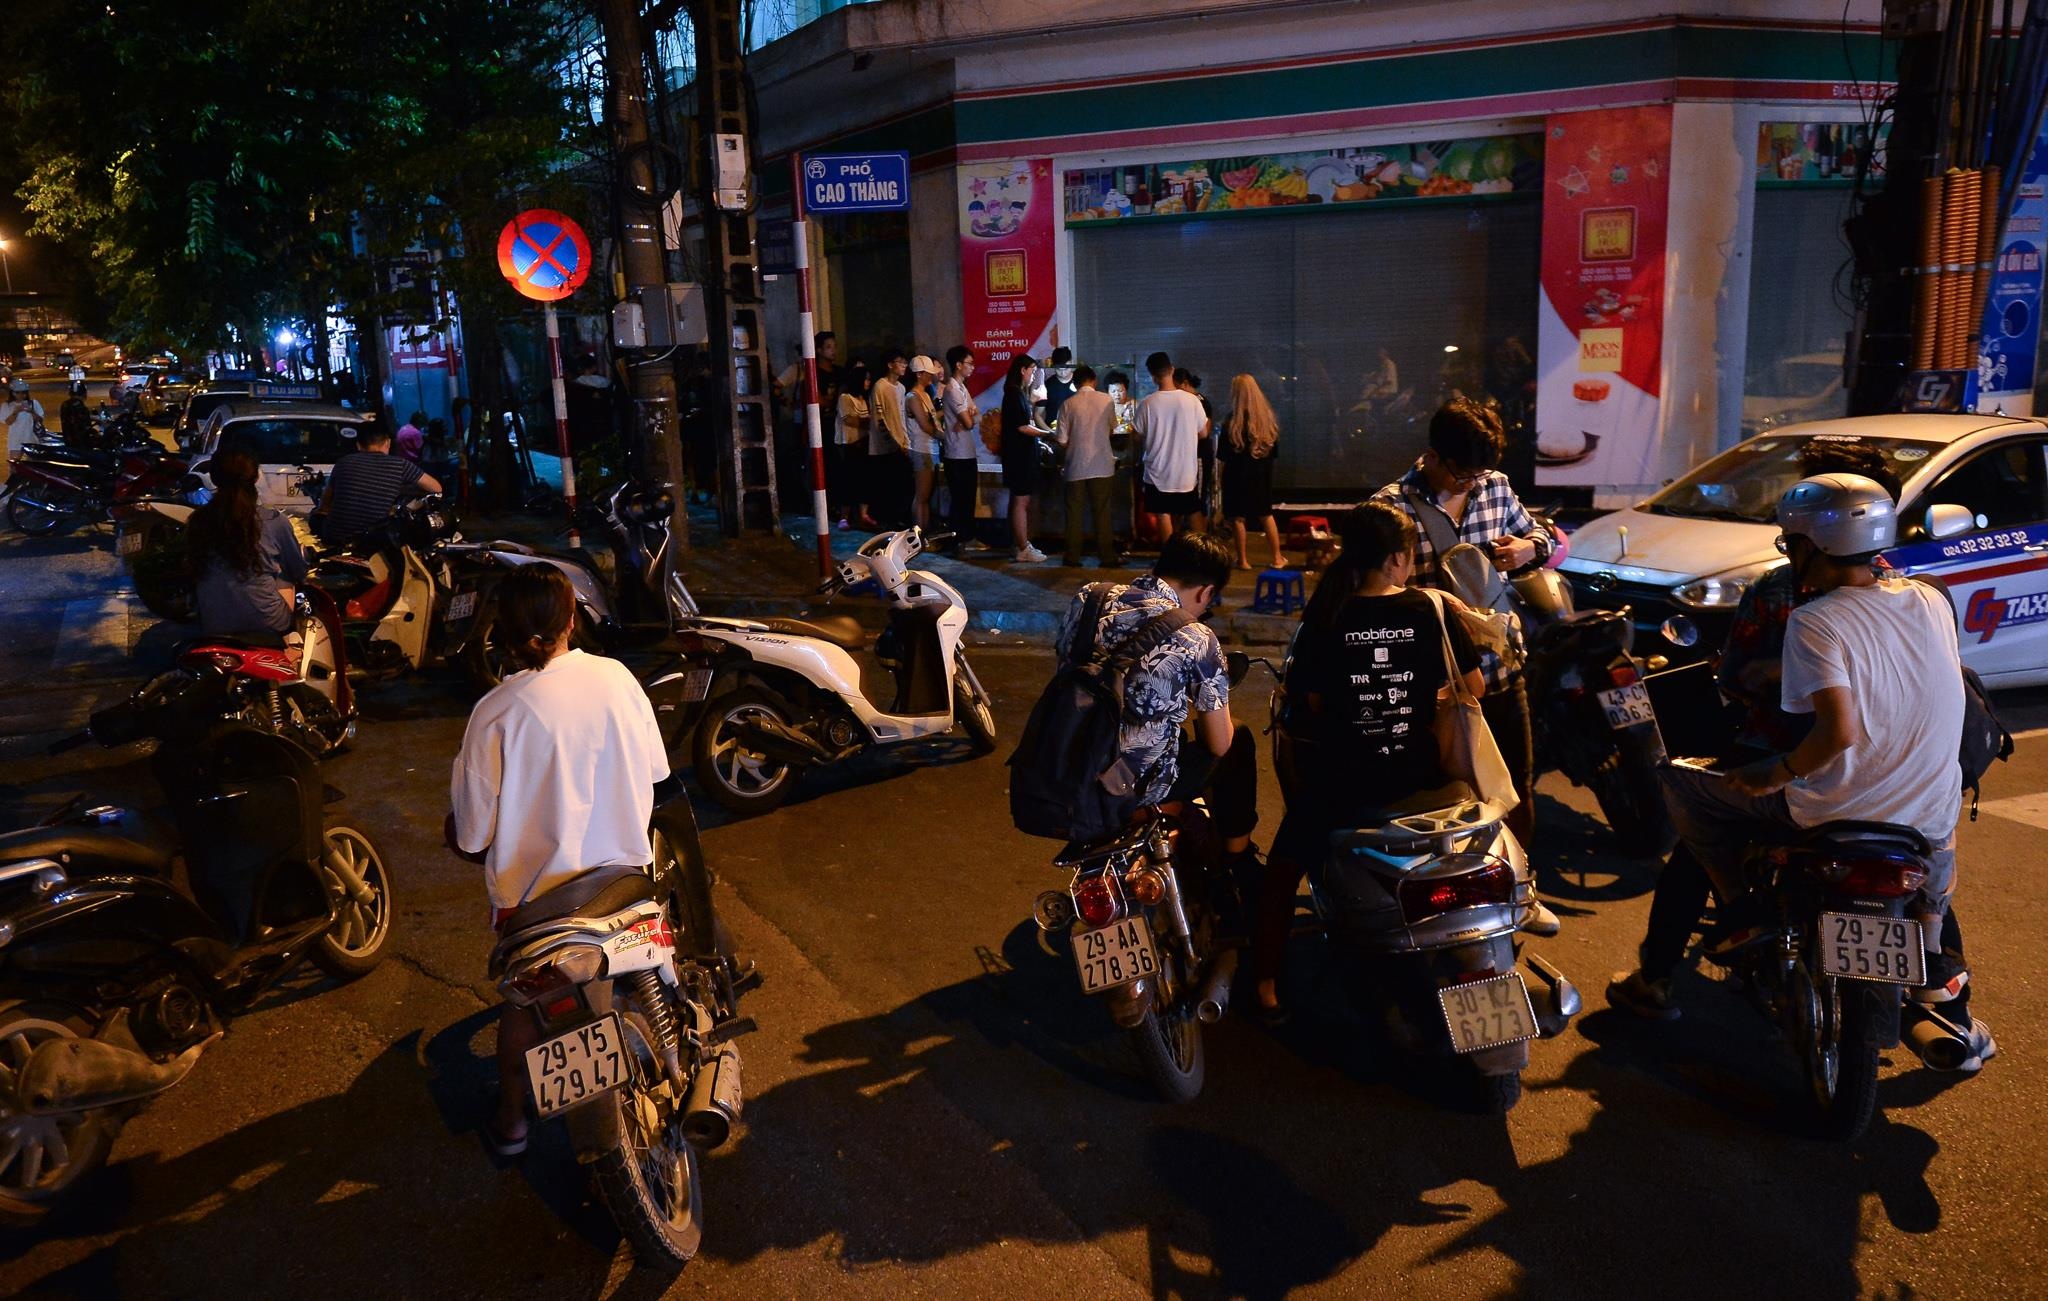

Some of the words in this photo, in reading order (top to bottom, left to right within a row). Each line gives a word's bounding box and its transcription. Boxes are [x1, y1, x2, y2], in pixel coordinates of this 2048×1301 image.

[840, 160, 872, 176] PHỐ
[815, 183, 846, 203] CAO
[849, 174, 898, 202] THẮNG
[972, 340, 1006, 349] TRUNG
[1008, 339, 1029, 348] THU
[991, 351, 1011, 361] 2019
[1917, 376, 1951, 408] G7
[1977, 536, 1996, 551] 32
[1994, 533, 2013, 548] 32
[2010, 530, 2030, 546] 32
[744, 635, 789, 645] VISION
[1345, 627, 1415, 642] mobifone
[1350, 674, 1370, 684] TNR
[1359, 693, 1377, 701] BIDV
[1853, 900, 1885, 908] HONDA
[1083, 922, 1140, 959] 29-AA
[1835, 917, 1907, 949] 29-Z9
[1084, 947, 1153, 989] 278.36
[1837, 946, 1910, 979] 5598
[1451, 980, 1516, 1017] 30-K2
[1460, 1009, 1523, 1045] 6273
[538, 1022, 608, 1077] 29-Y5
[540, 1052, 620, 1111] 429.47
